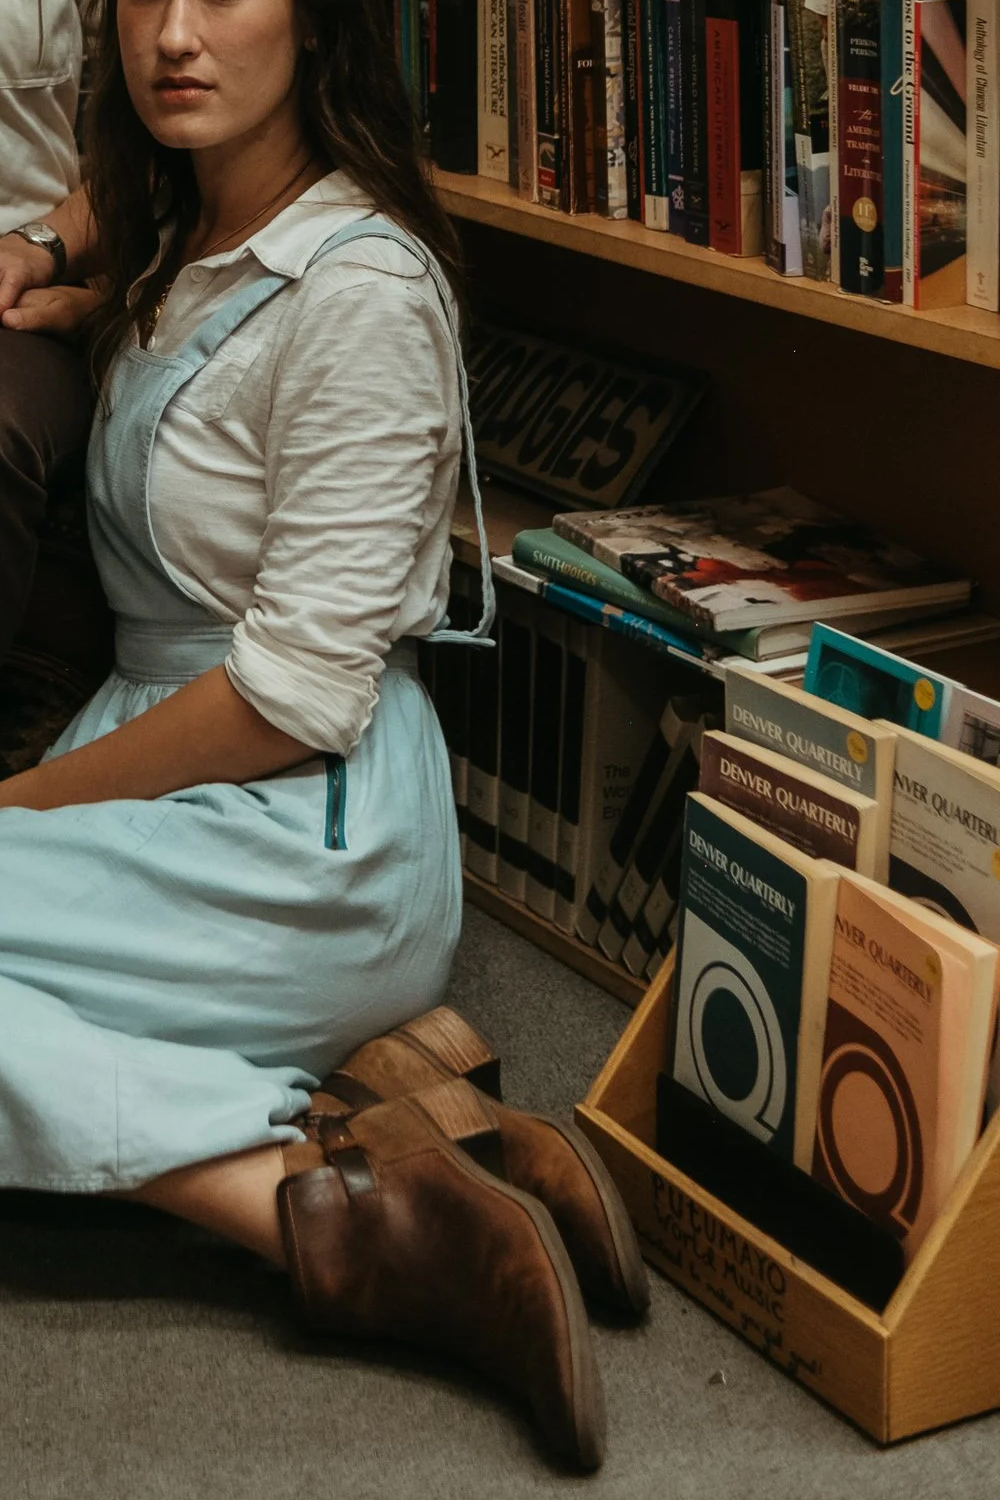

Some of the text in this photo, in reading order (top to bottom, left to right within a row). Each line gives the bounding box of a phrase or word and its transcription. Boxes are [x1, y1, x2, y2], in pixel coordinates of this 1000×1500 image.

[904, 29, 916, 45] to
[904, 50, 916, 77] the
[490, 44, 499, 116] LITERATURE
[713, 29, 724, 202] AMERICAN LITERATURE
[904, 81, 917, 145] Ground
[973, 17, 988, 159] Anthology of Chinese Literature
[731, 703, 864, 783] DENVER QUARTERLY
[719, 757, 858, 841] DENVER QUARTERLY
[689, 829, 796, 918] DENVER QUARTERLY
